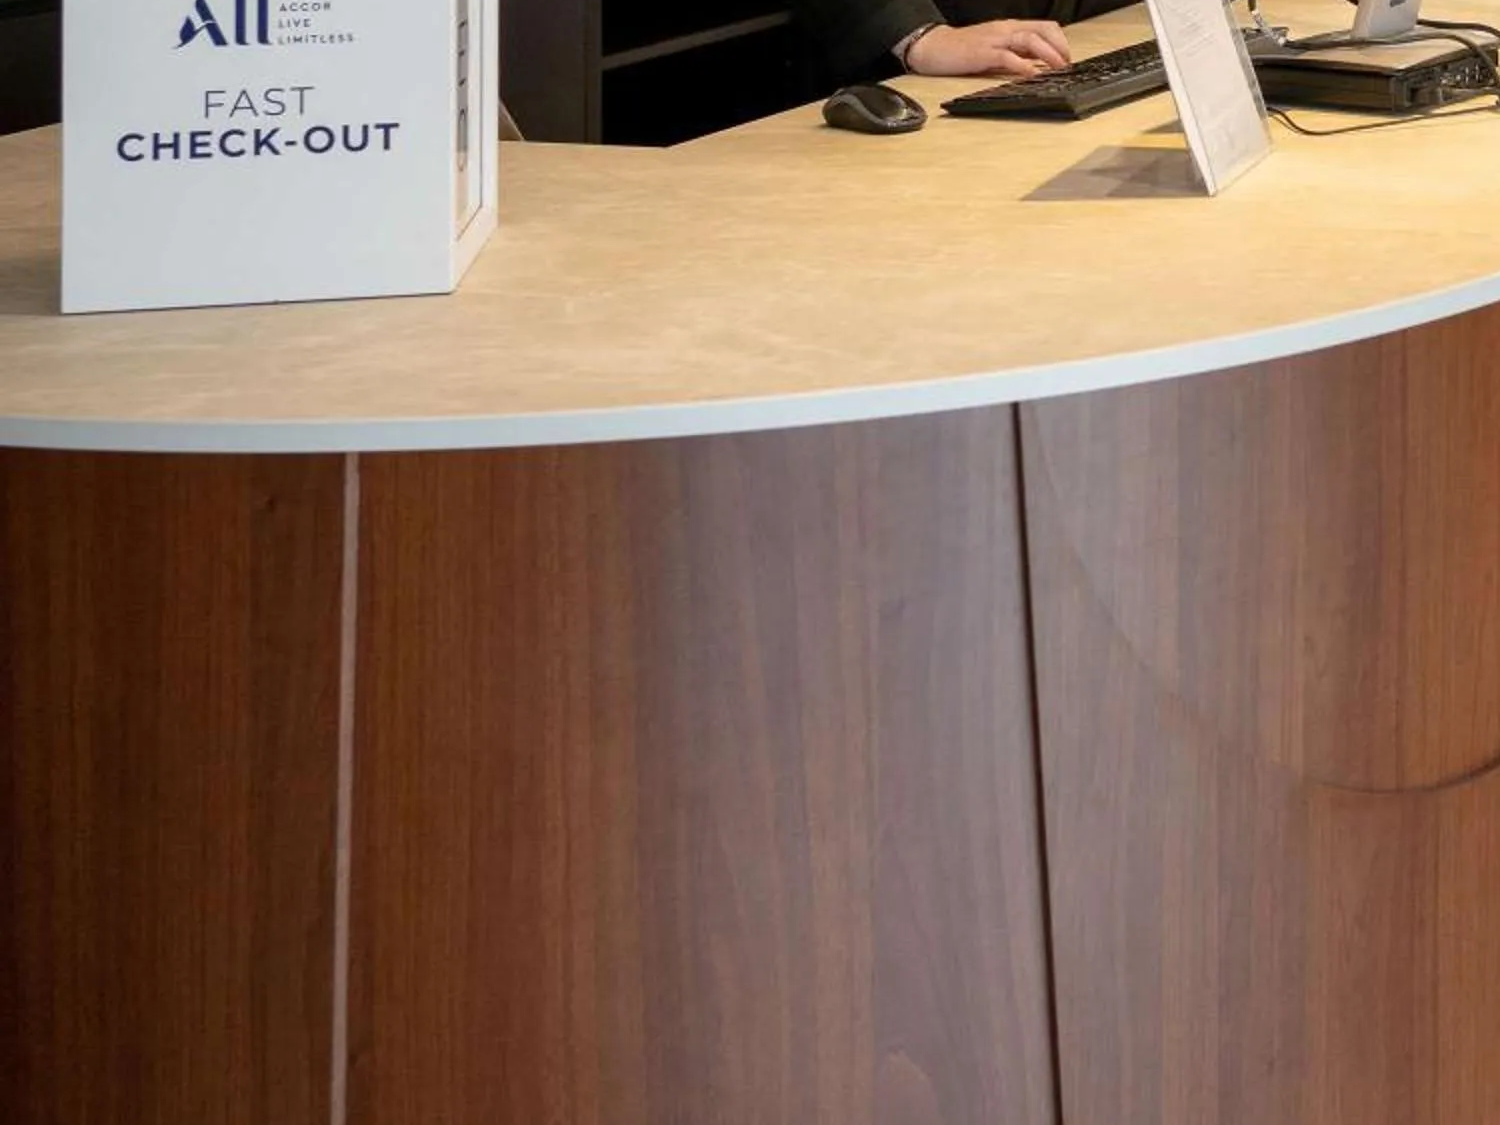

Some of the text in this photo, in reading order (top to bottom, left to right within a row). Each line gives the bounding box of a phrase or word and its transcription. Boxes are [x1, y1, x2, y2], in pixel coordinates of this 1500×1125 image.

[279, 1, 332, 13] ACCOR
[278, 18, 312, 29] LIVE
[277, 33, 355, 46] LIMITLESS
[203, 85, 316, 119] FAST
[115, 121, 401, 163] CHECK-OUT
